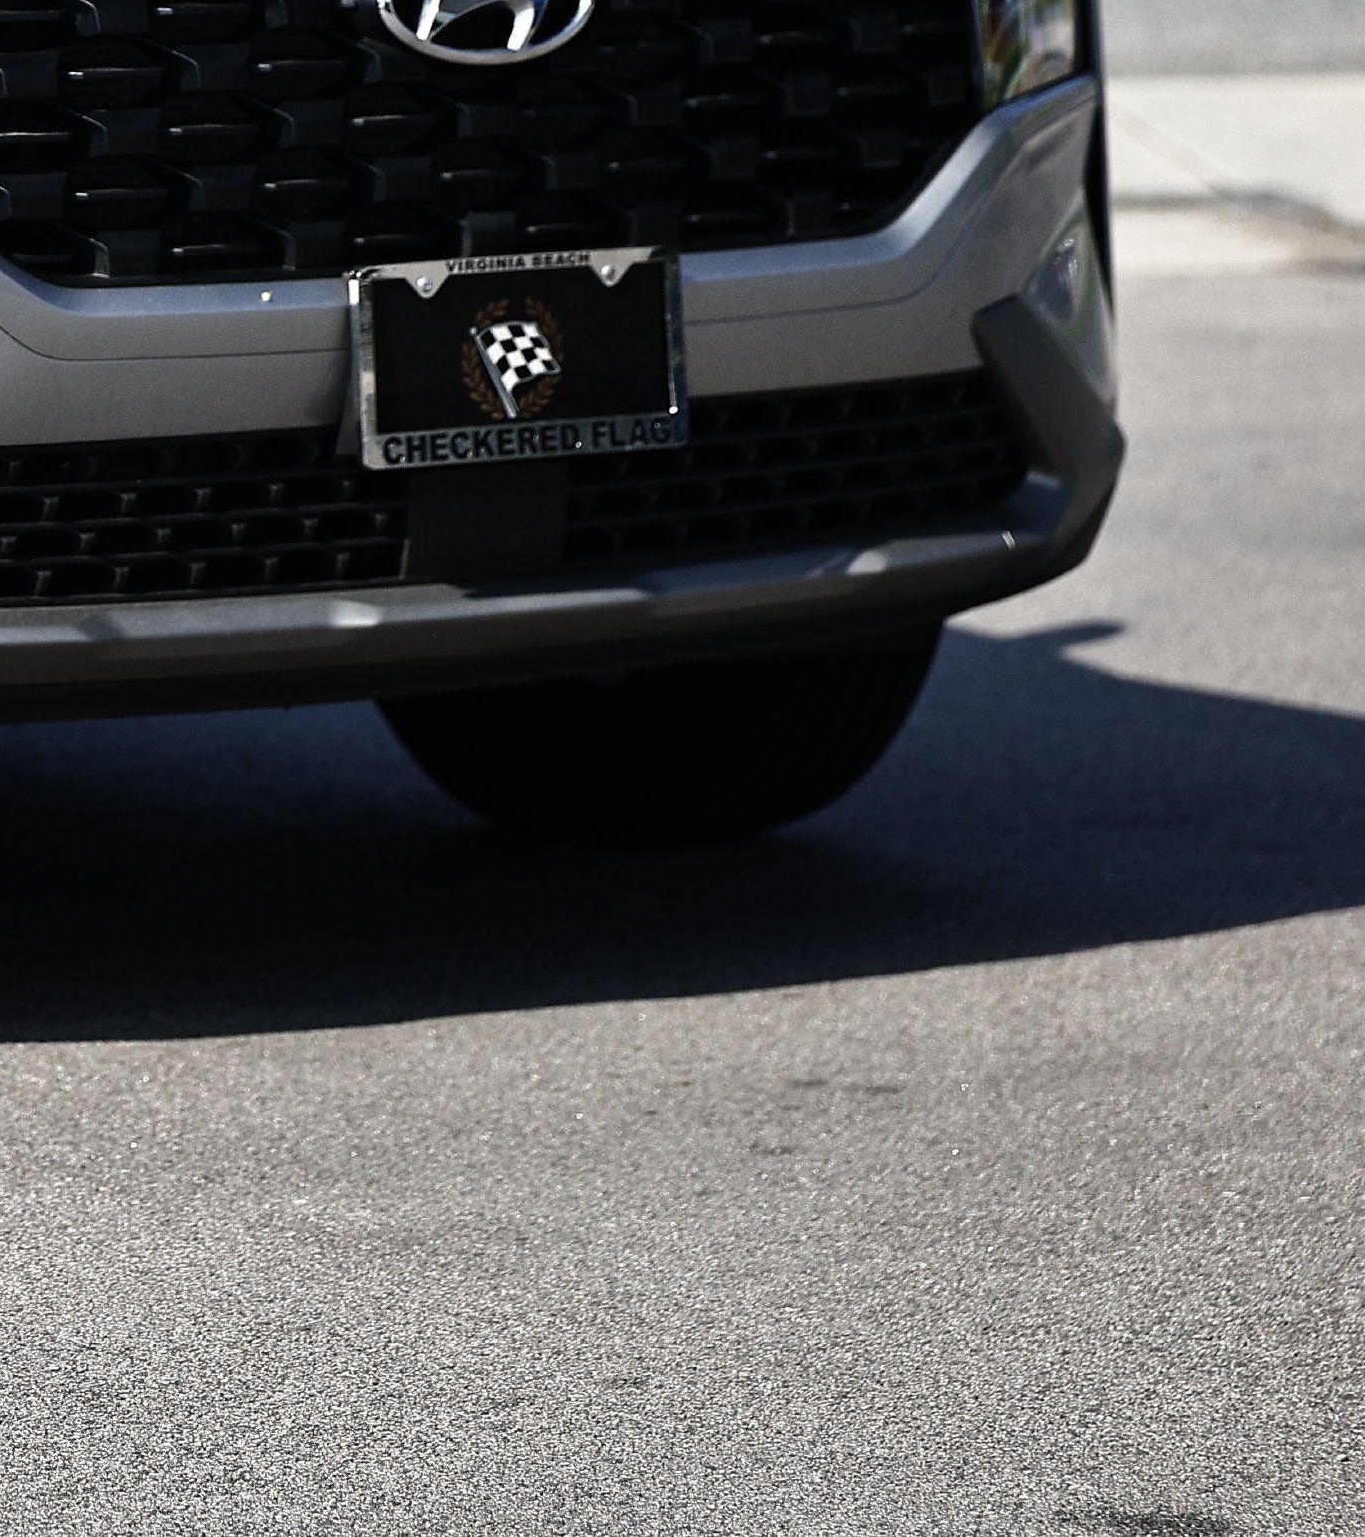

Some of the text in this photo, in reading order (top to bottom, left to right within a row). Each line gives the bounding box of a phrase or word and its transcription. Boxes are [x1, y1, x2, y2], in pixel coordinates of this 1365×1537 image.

[445, 252, 590, 272] VIRGINIA BEACH
[383, 417, 671, 464] CHECKERED FLAG
